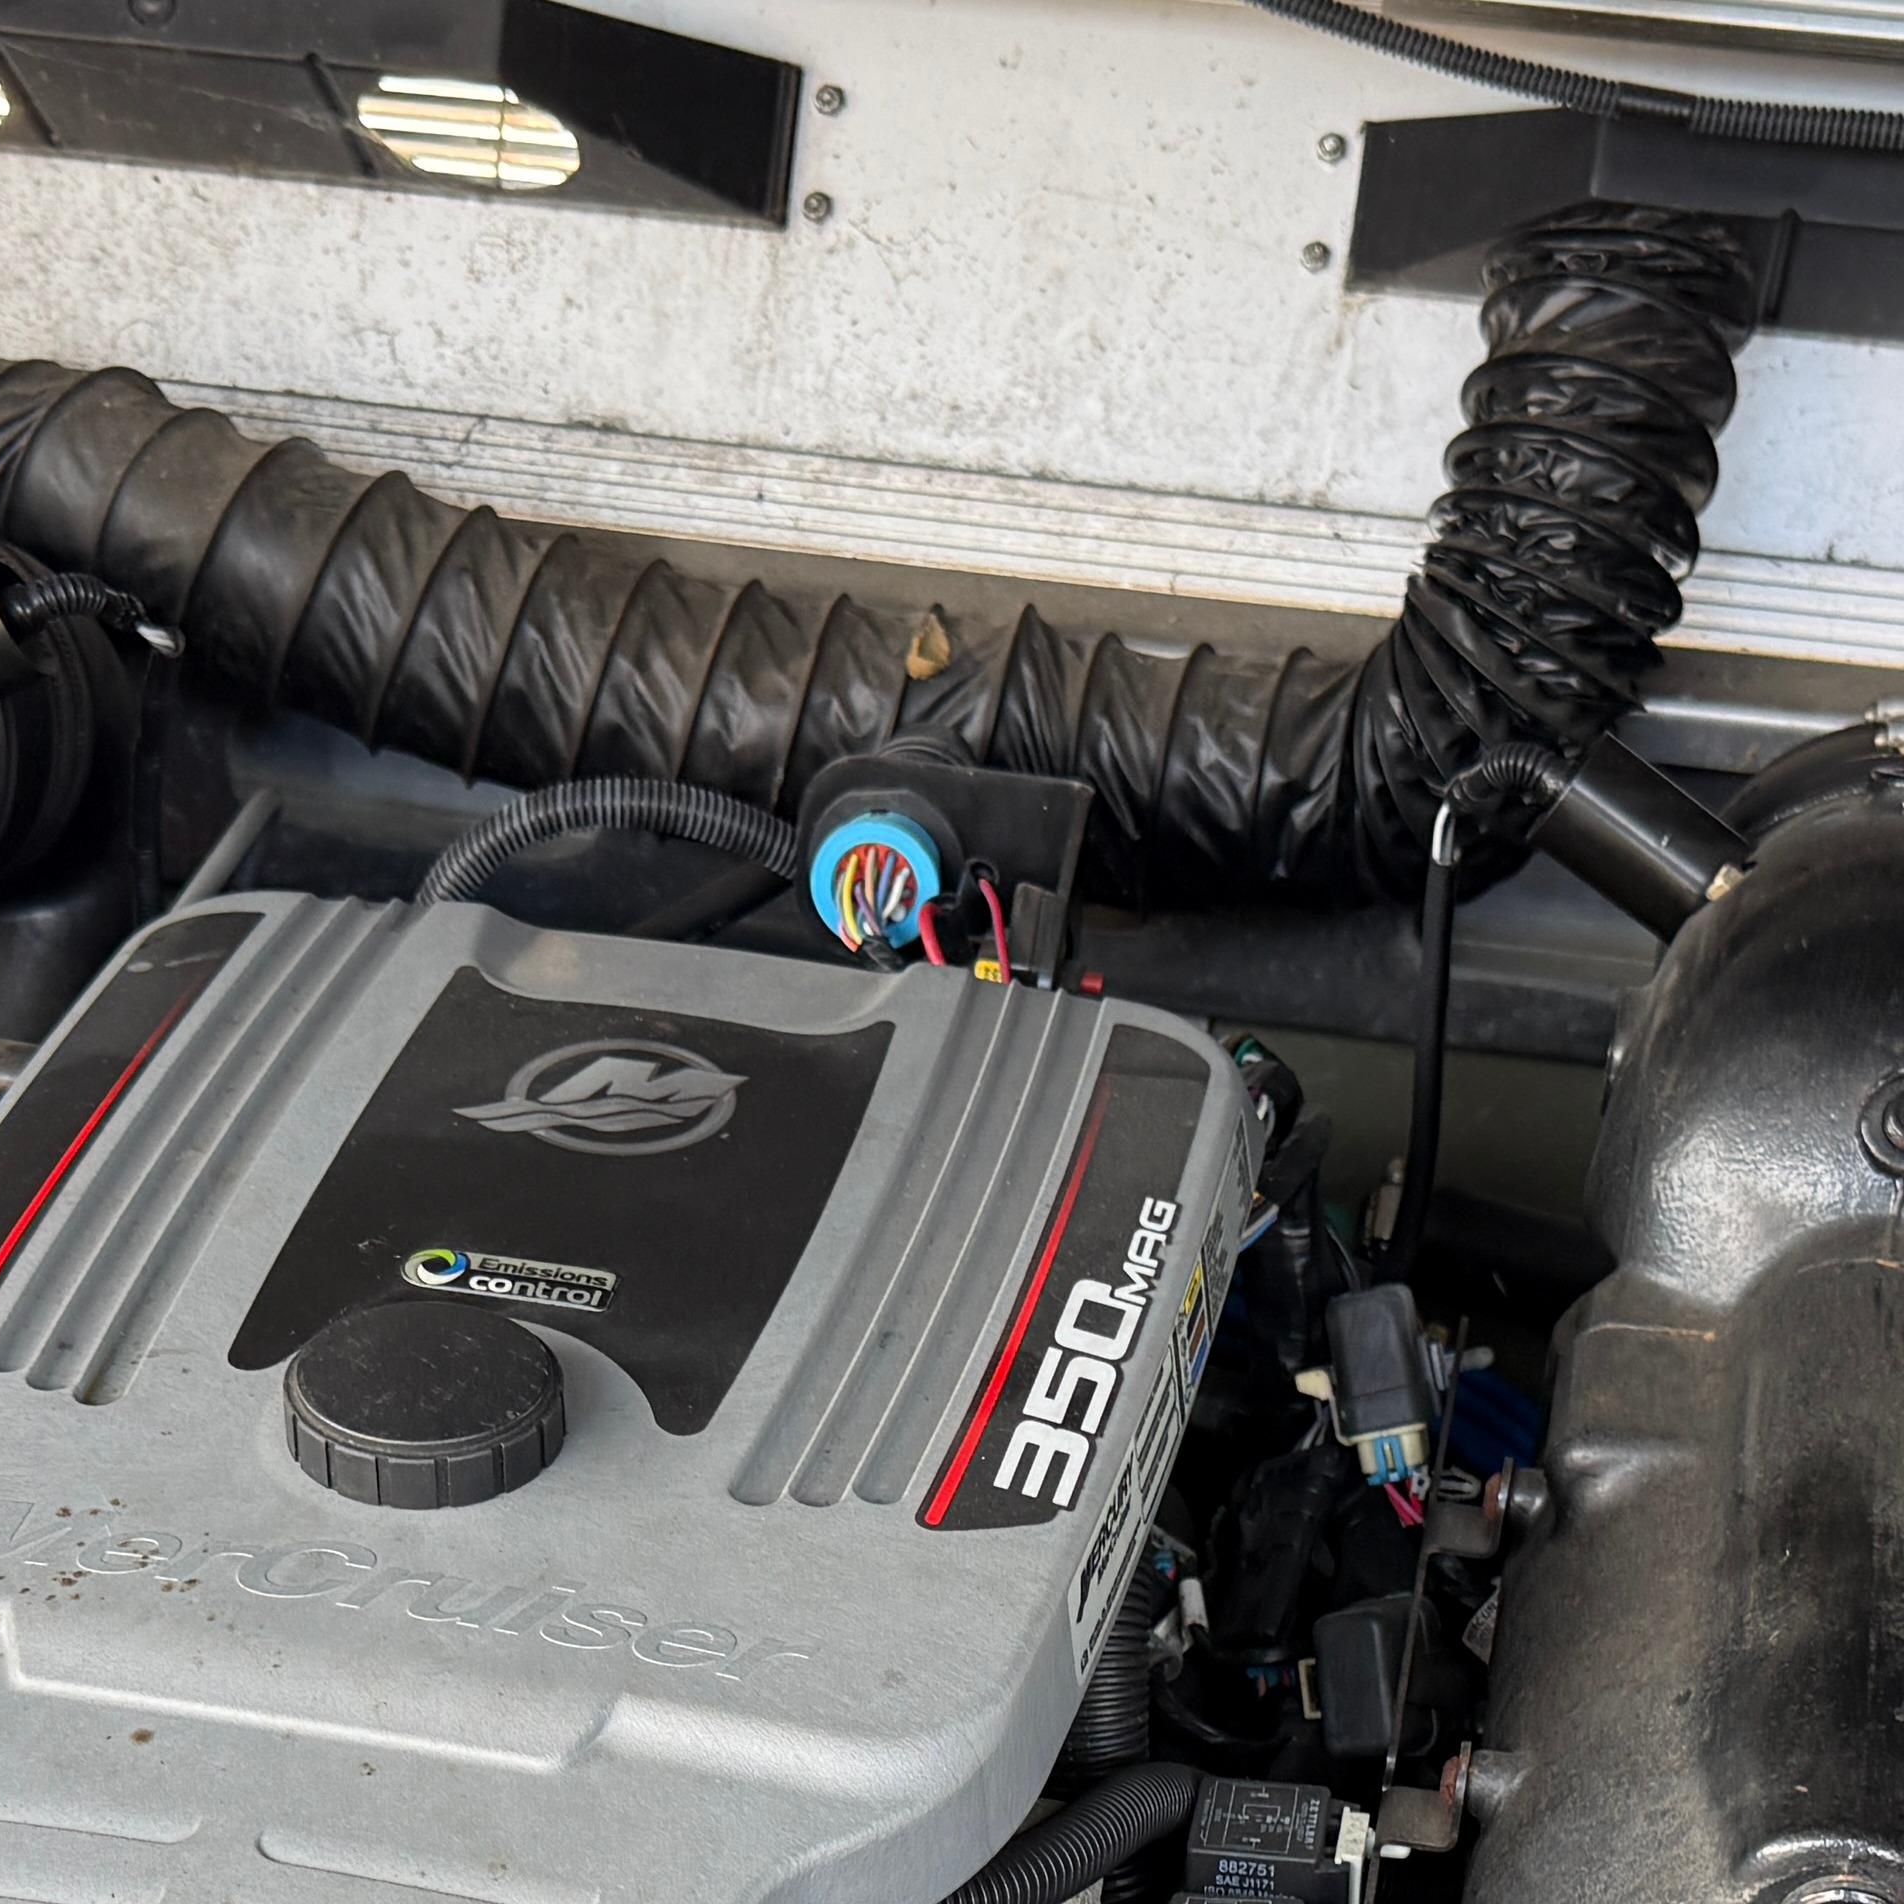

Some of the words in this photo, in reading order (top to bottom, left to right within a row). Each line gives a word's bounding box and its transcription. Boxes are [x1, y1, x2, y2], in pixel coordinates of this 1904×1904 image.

[478, 1258, 609, 1288] Emissions
[468, 1274, 603, 1308] control
[993, 1279, 1143, 1507] 350
[1113, 1197, 1177, 1306] MAG
[1304, 1799, 1320, 1845] ZETTLER
[1215, 1875, 1240, 1887] SAE
[1243, 1876, 1275, 1890] J1171
[1218, 1859, 1275, 1878] 882751
